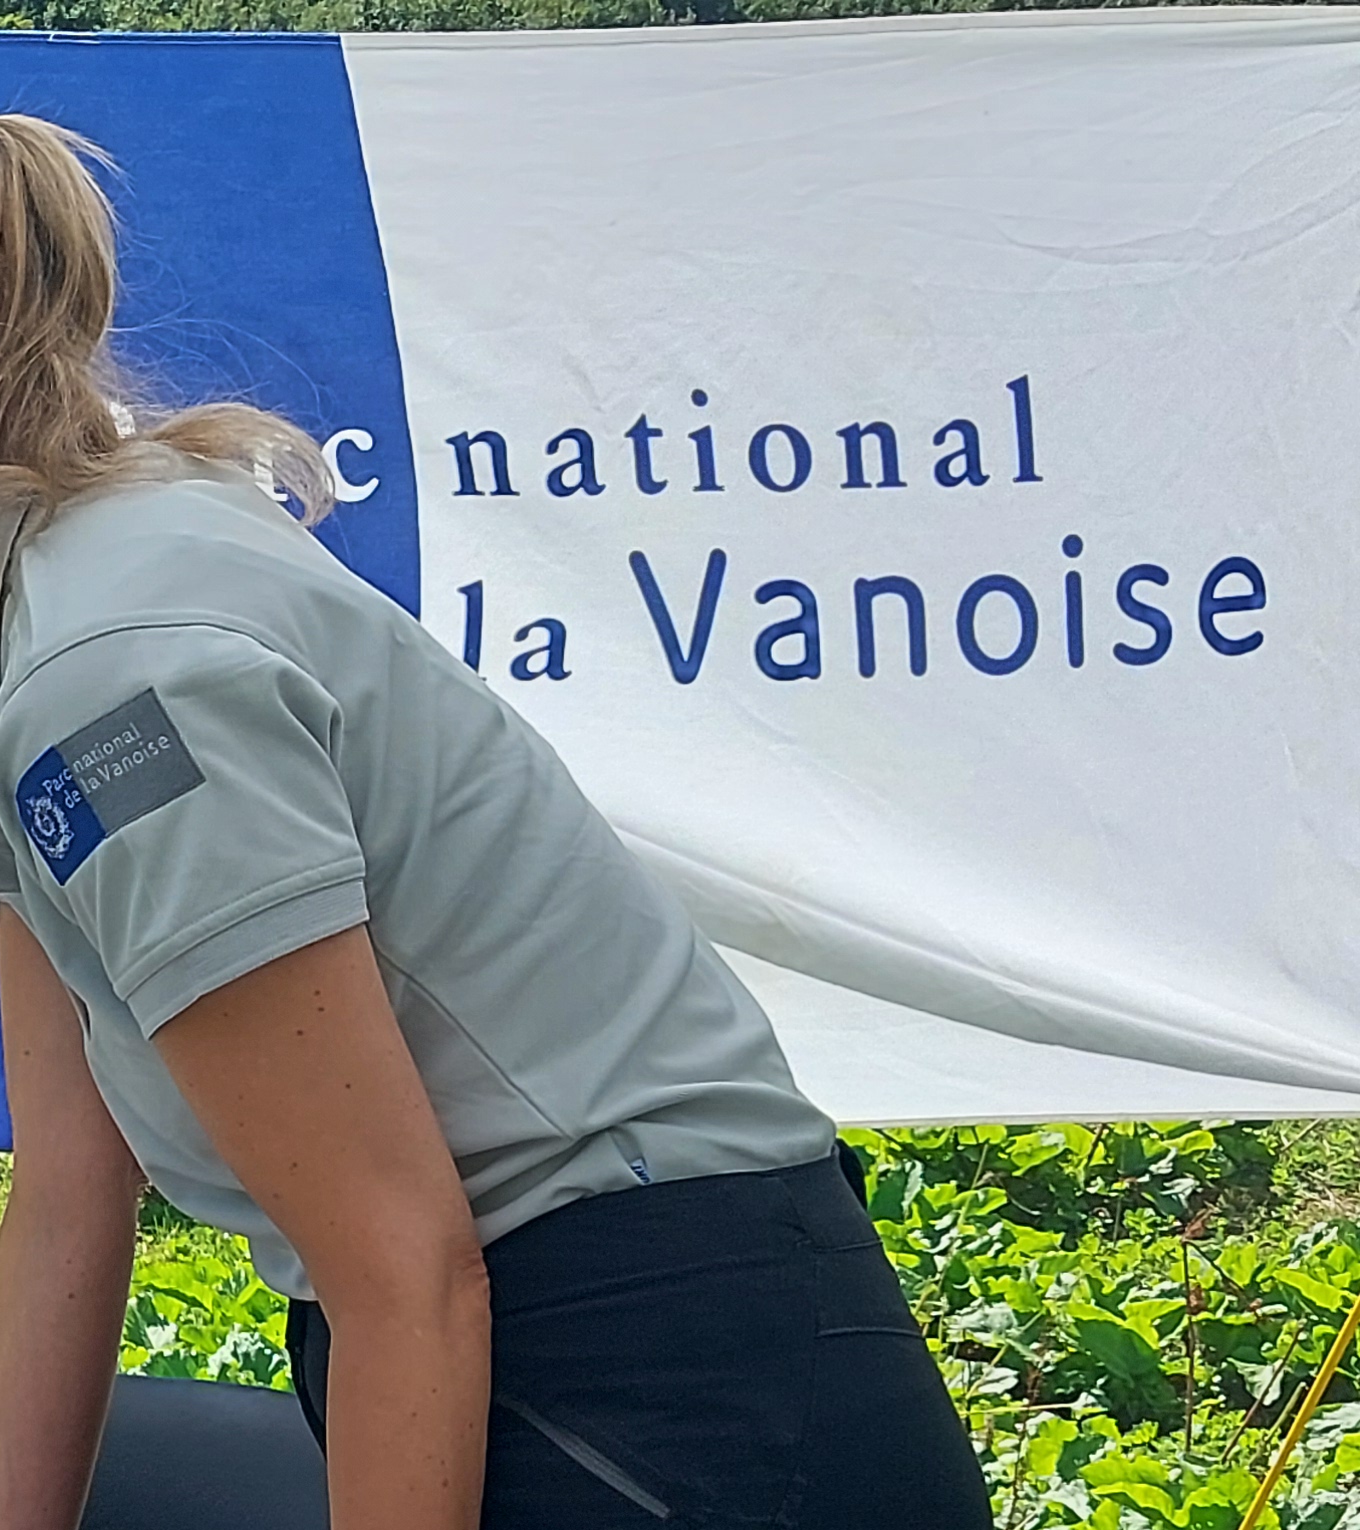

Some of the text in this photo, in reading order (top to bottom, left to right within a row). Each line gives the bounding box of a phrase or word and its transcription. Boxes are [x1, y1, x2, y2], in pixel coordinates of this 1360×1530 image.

[444, 375, 1045, 497] national
[457, 533, 1267, 685] la Vanoise
[41, 722, 143, 797] Parc national
[64, 733, 172, 810] de la Vanoise
